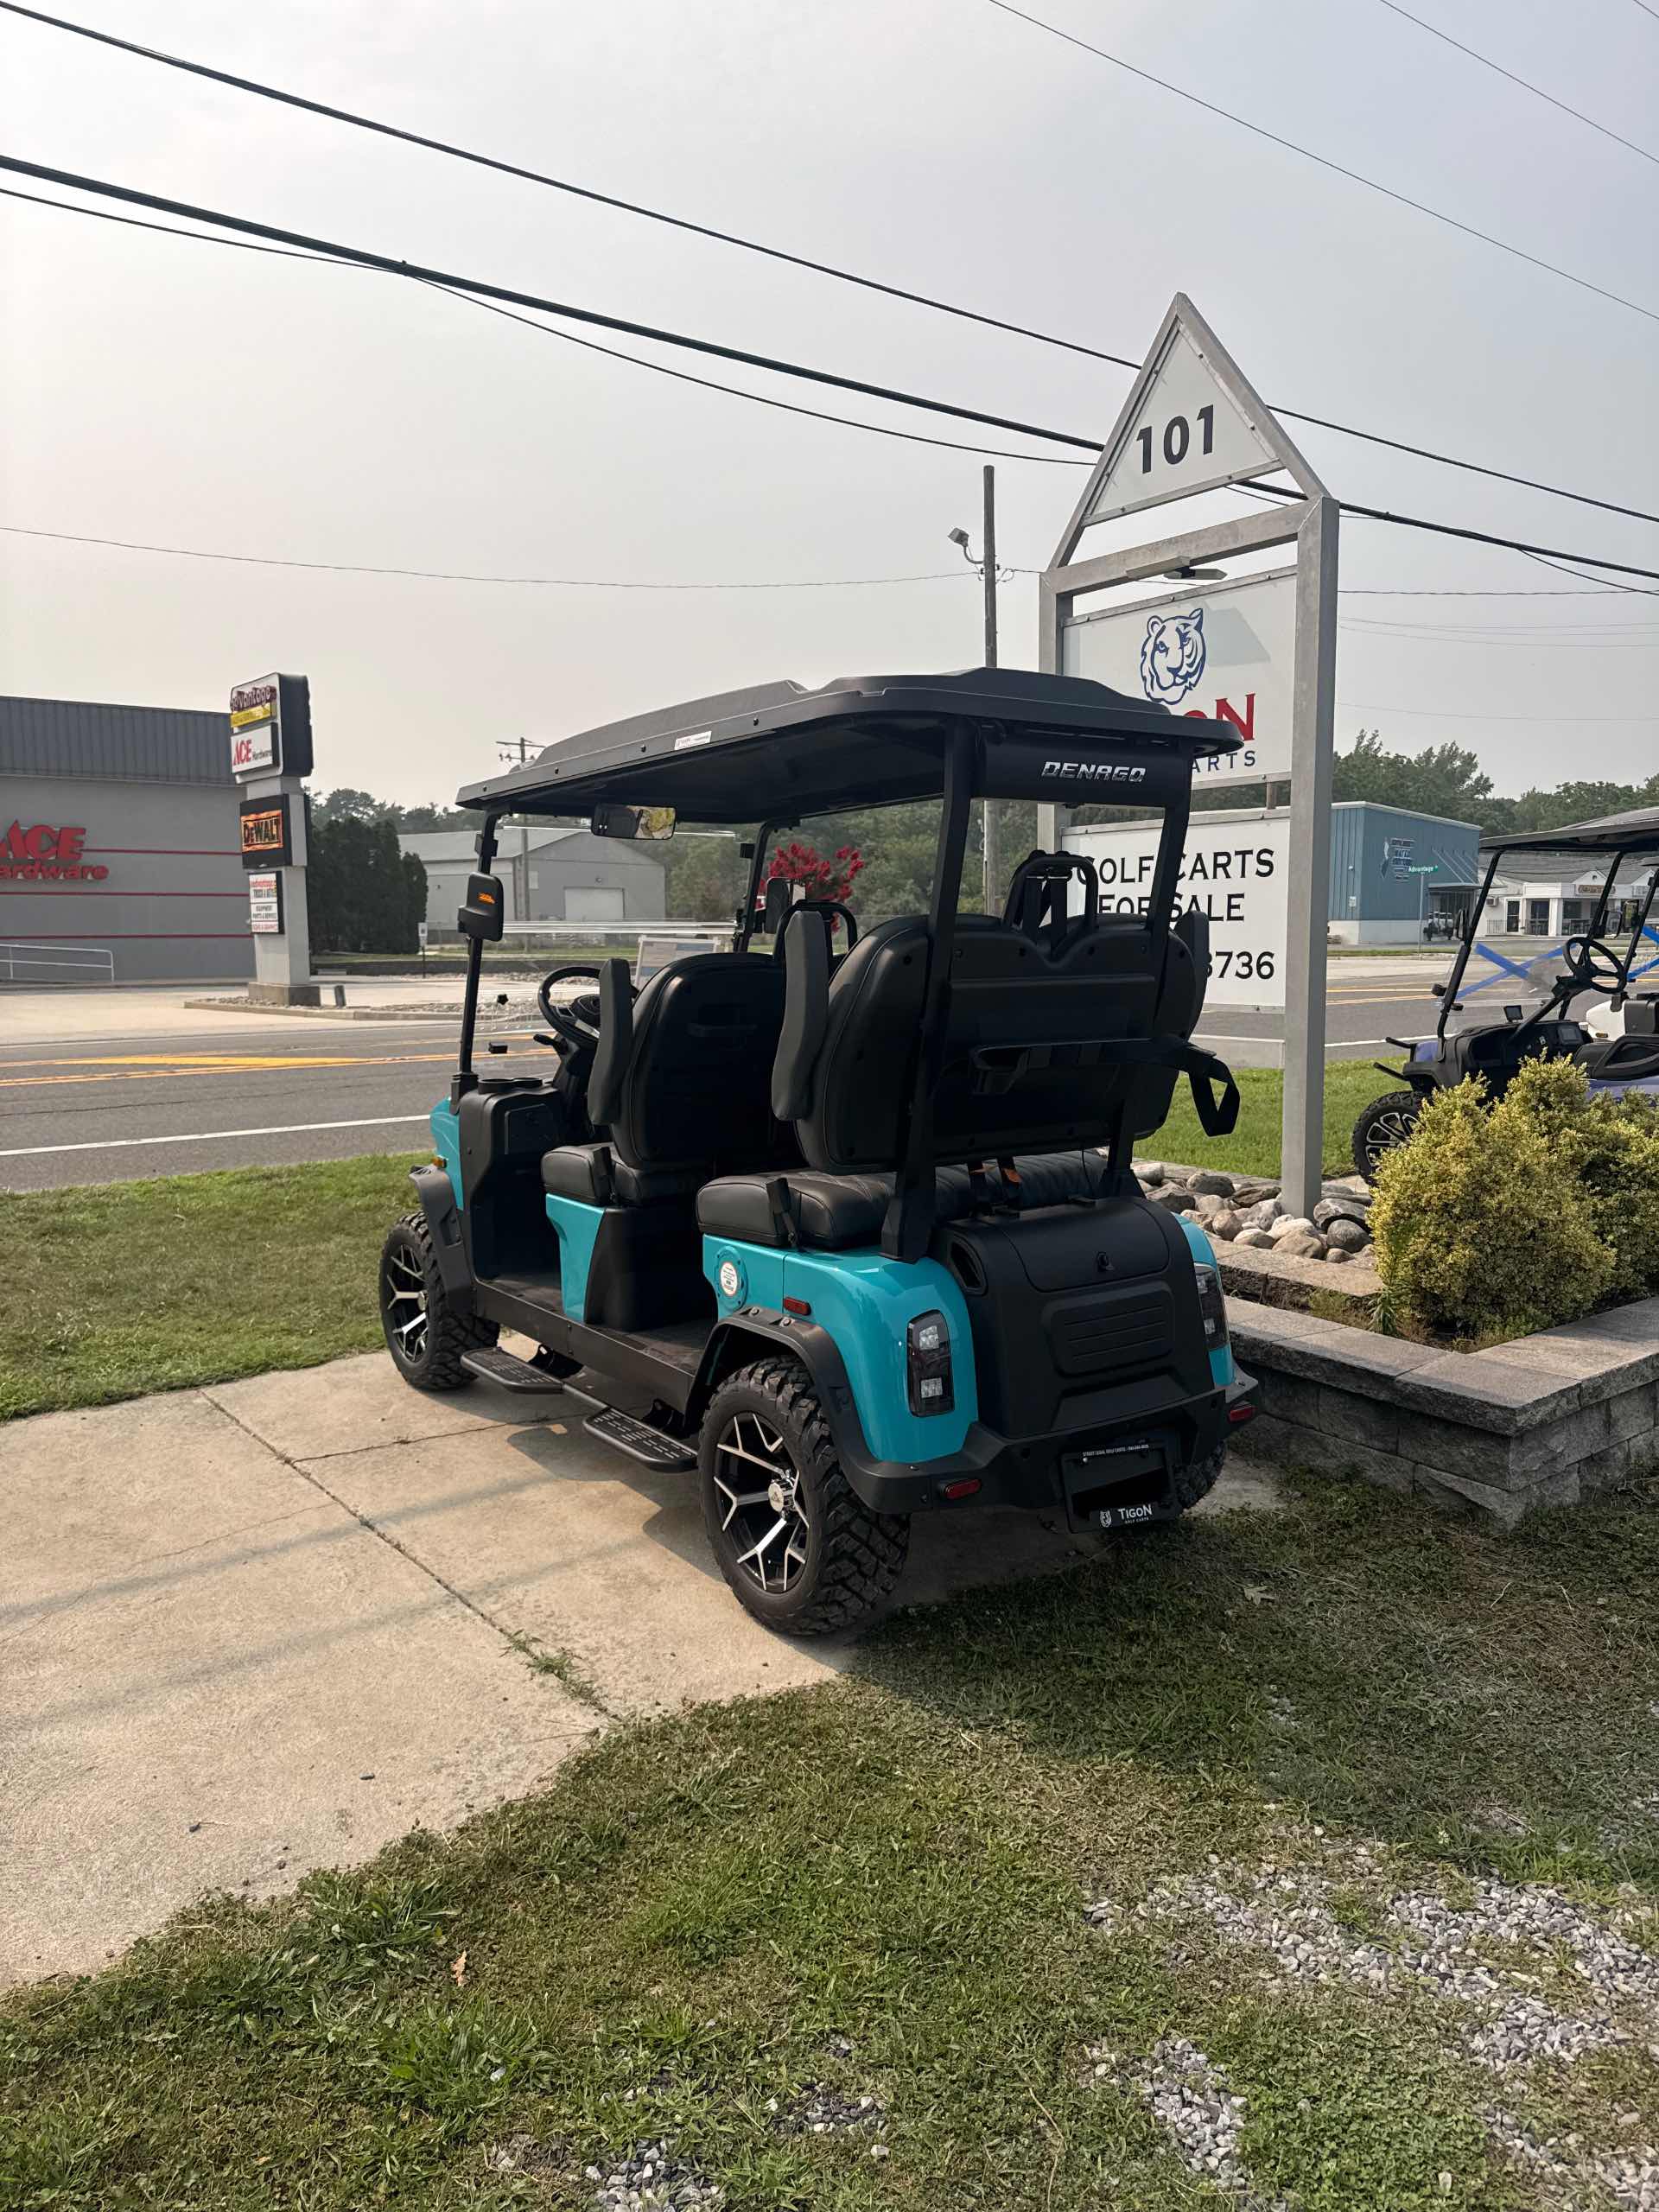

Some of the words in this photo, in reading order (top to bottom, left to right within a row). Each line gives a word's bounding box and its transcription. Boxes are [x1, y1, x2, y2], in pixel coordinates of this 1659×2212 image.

[1136, 404, 1214, 474] 101
[233, 740, 252, 766] ACE
[1191, 750, 1255, 772] ARTS
[1041, 761, 1147, 782] DENAGO
[0, 818, 86, 861] ACE
[0, 863, 110, 880] ardware
[1077, 855, 1154, 884] OLF
[1177, 849, 1274, 880] ARTS
[1207, 950, 1274, 979] 736
[1117, 1503, 1154, 1520] TIGON
